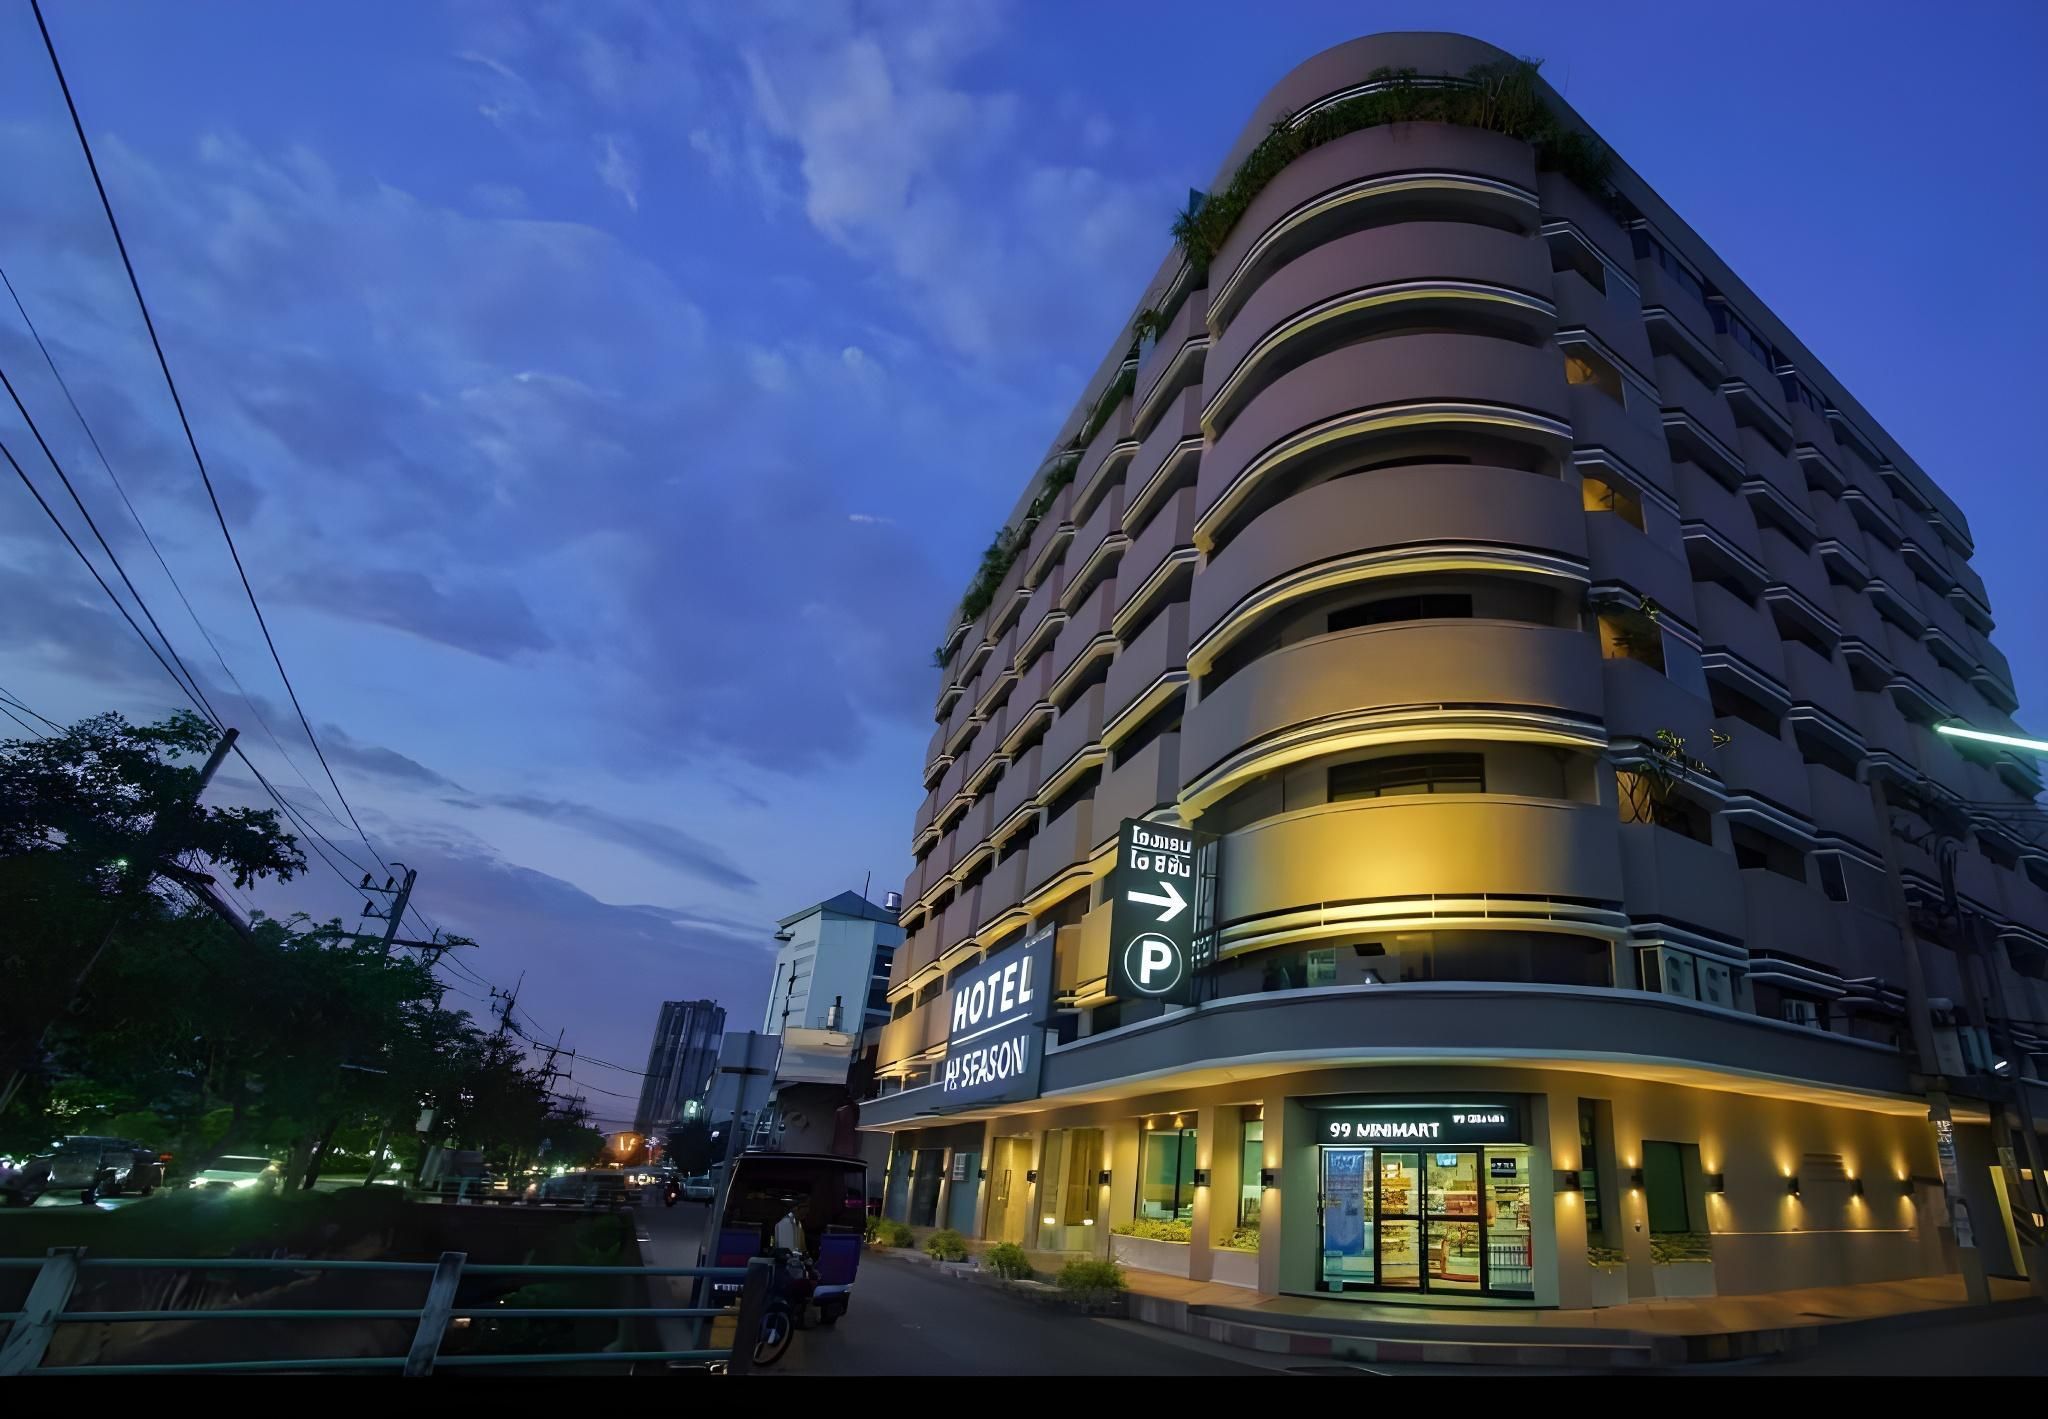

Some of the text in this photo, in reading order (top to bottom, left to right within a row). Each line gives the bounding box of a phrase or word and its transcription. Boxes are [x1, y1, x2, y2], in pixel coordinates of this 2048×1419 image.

[1141, 940, 1172, 984] P
[952, 956, 1032, 1033] HOTEL
[961, 1035, 1029, 1088] SEASON
[1330, 1122, 1351, 1138] 99
